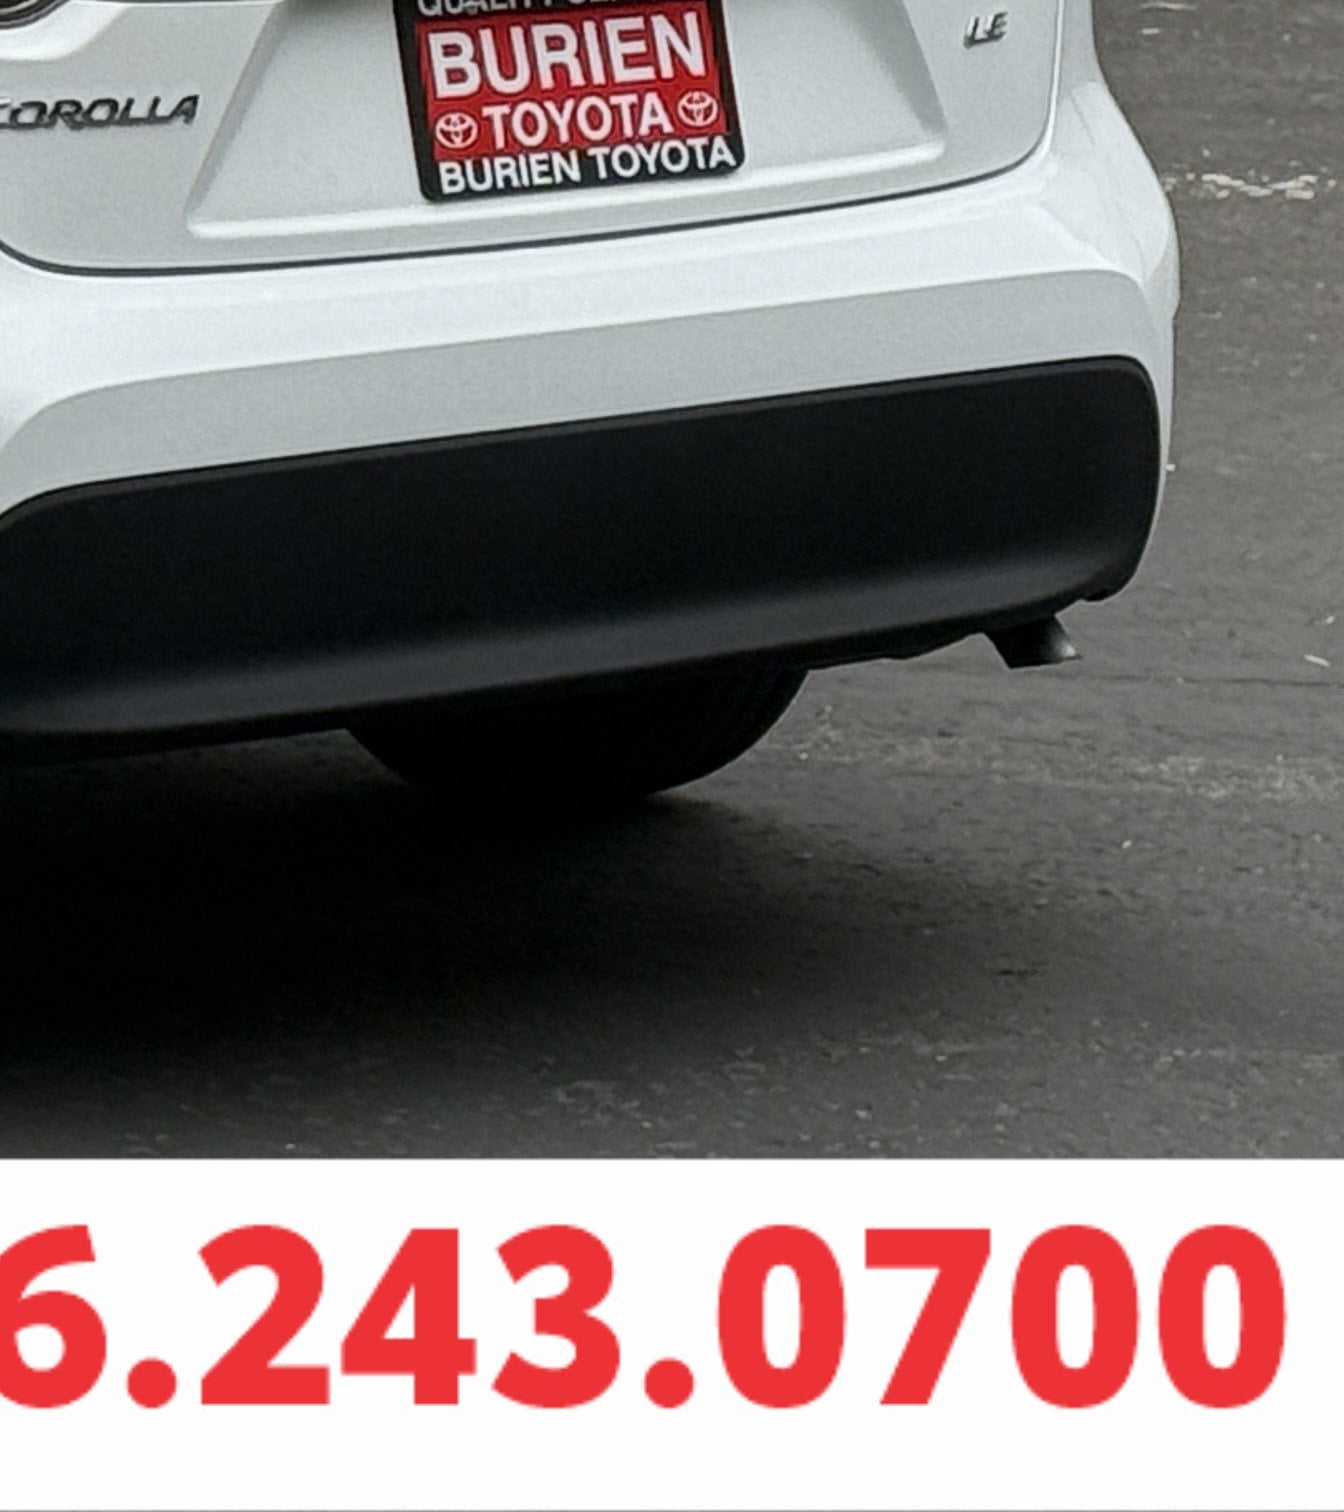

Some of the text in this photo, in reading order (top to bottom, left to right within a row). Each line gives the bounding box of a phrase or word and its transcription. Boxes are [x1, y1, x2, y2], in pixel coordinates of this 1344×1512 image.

[426, 10, 708, 100] BURIEN
[963, 10, 1009, 49] LE
[480, 90, 675, 151] TOYOTA
[438, 134, 738, 196] BURIEN TOYOTA
